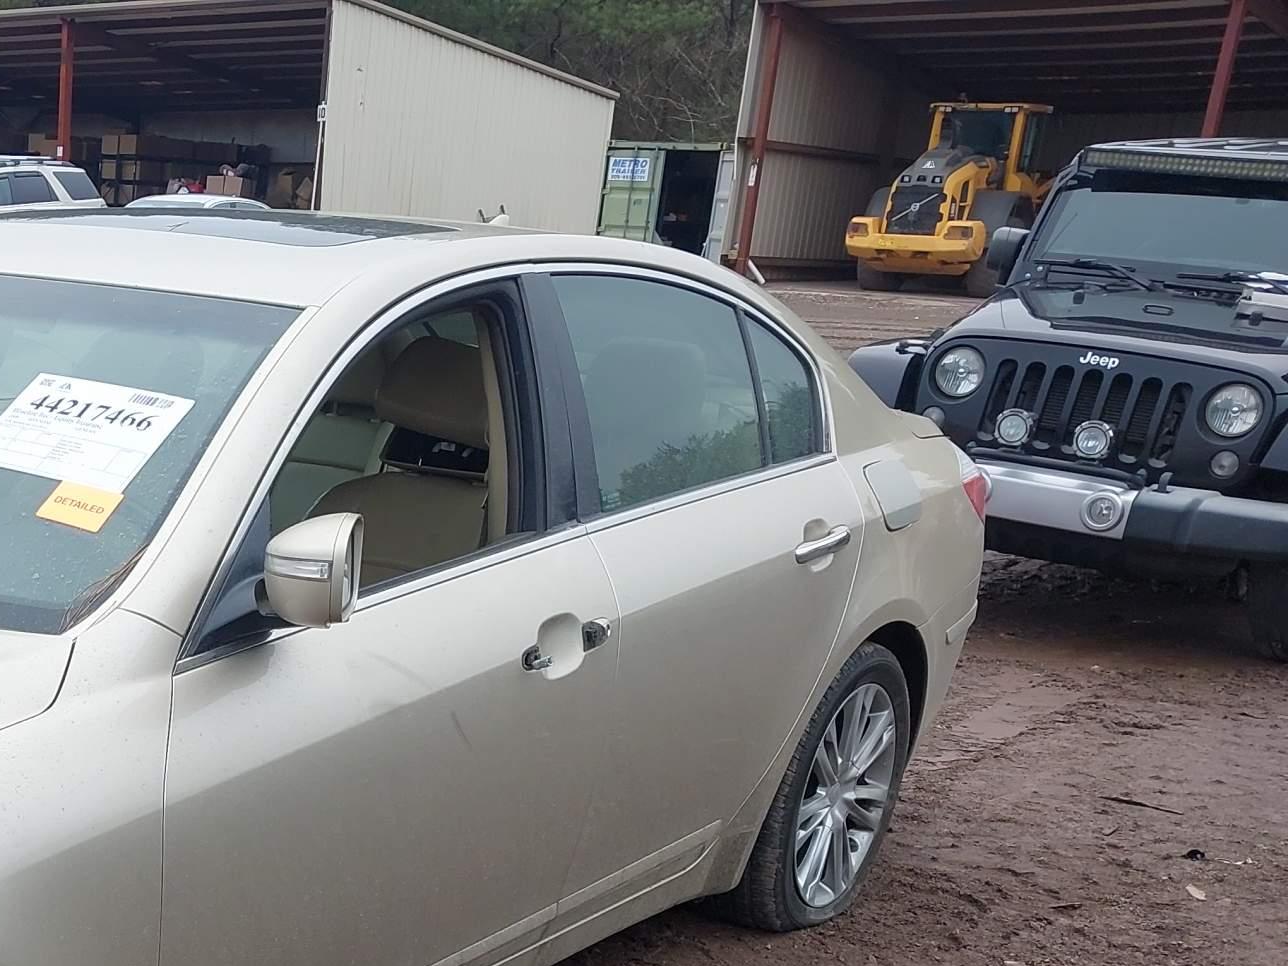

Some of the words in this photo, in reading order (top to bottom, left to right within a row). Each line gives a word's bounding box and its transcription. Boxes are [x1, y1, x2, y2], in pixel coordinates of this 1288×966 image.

[612, 159, 648, 168] METRO
[1079, 351, 1120, 370] Jeep
[30, 394, 160, 431] 44217466
[54, 495, 105, 514] DETAILED
